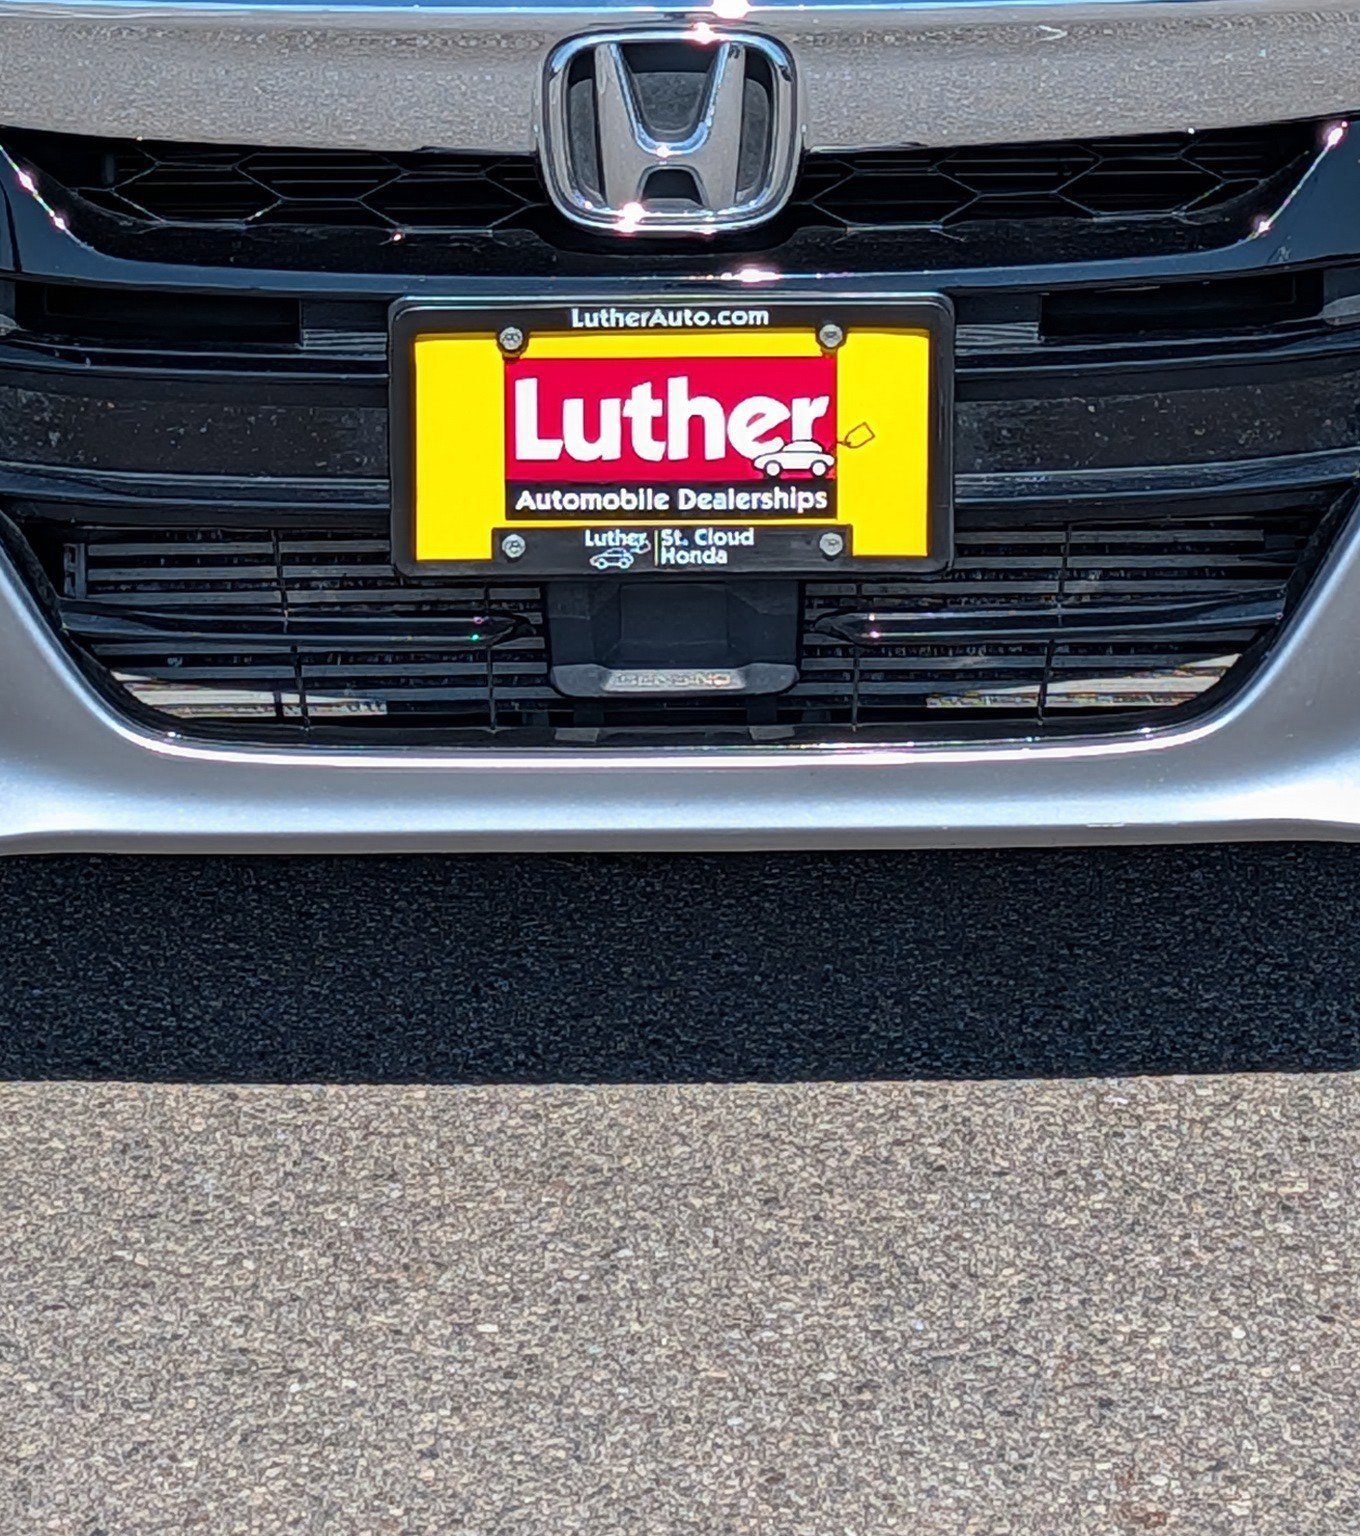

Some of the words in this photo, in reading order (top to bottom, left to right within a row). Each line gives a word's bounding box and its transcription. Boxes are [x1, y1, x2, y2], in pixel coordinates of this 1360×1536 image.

[570, 307, 770, 328] LutherAuto.com
[514, 375, 830, 462] Luther
[514, 487, 670, 511] Automobile
[677, 485, 828, 514] Dealerships
[584, 528, 648, 548] Luther
[660, 528, 688, 548] St.
[694, 526, 755, 547] Cloud
[660, 546, 729, 565] Honda
